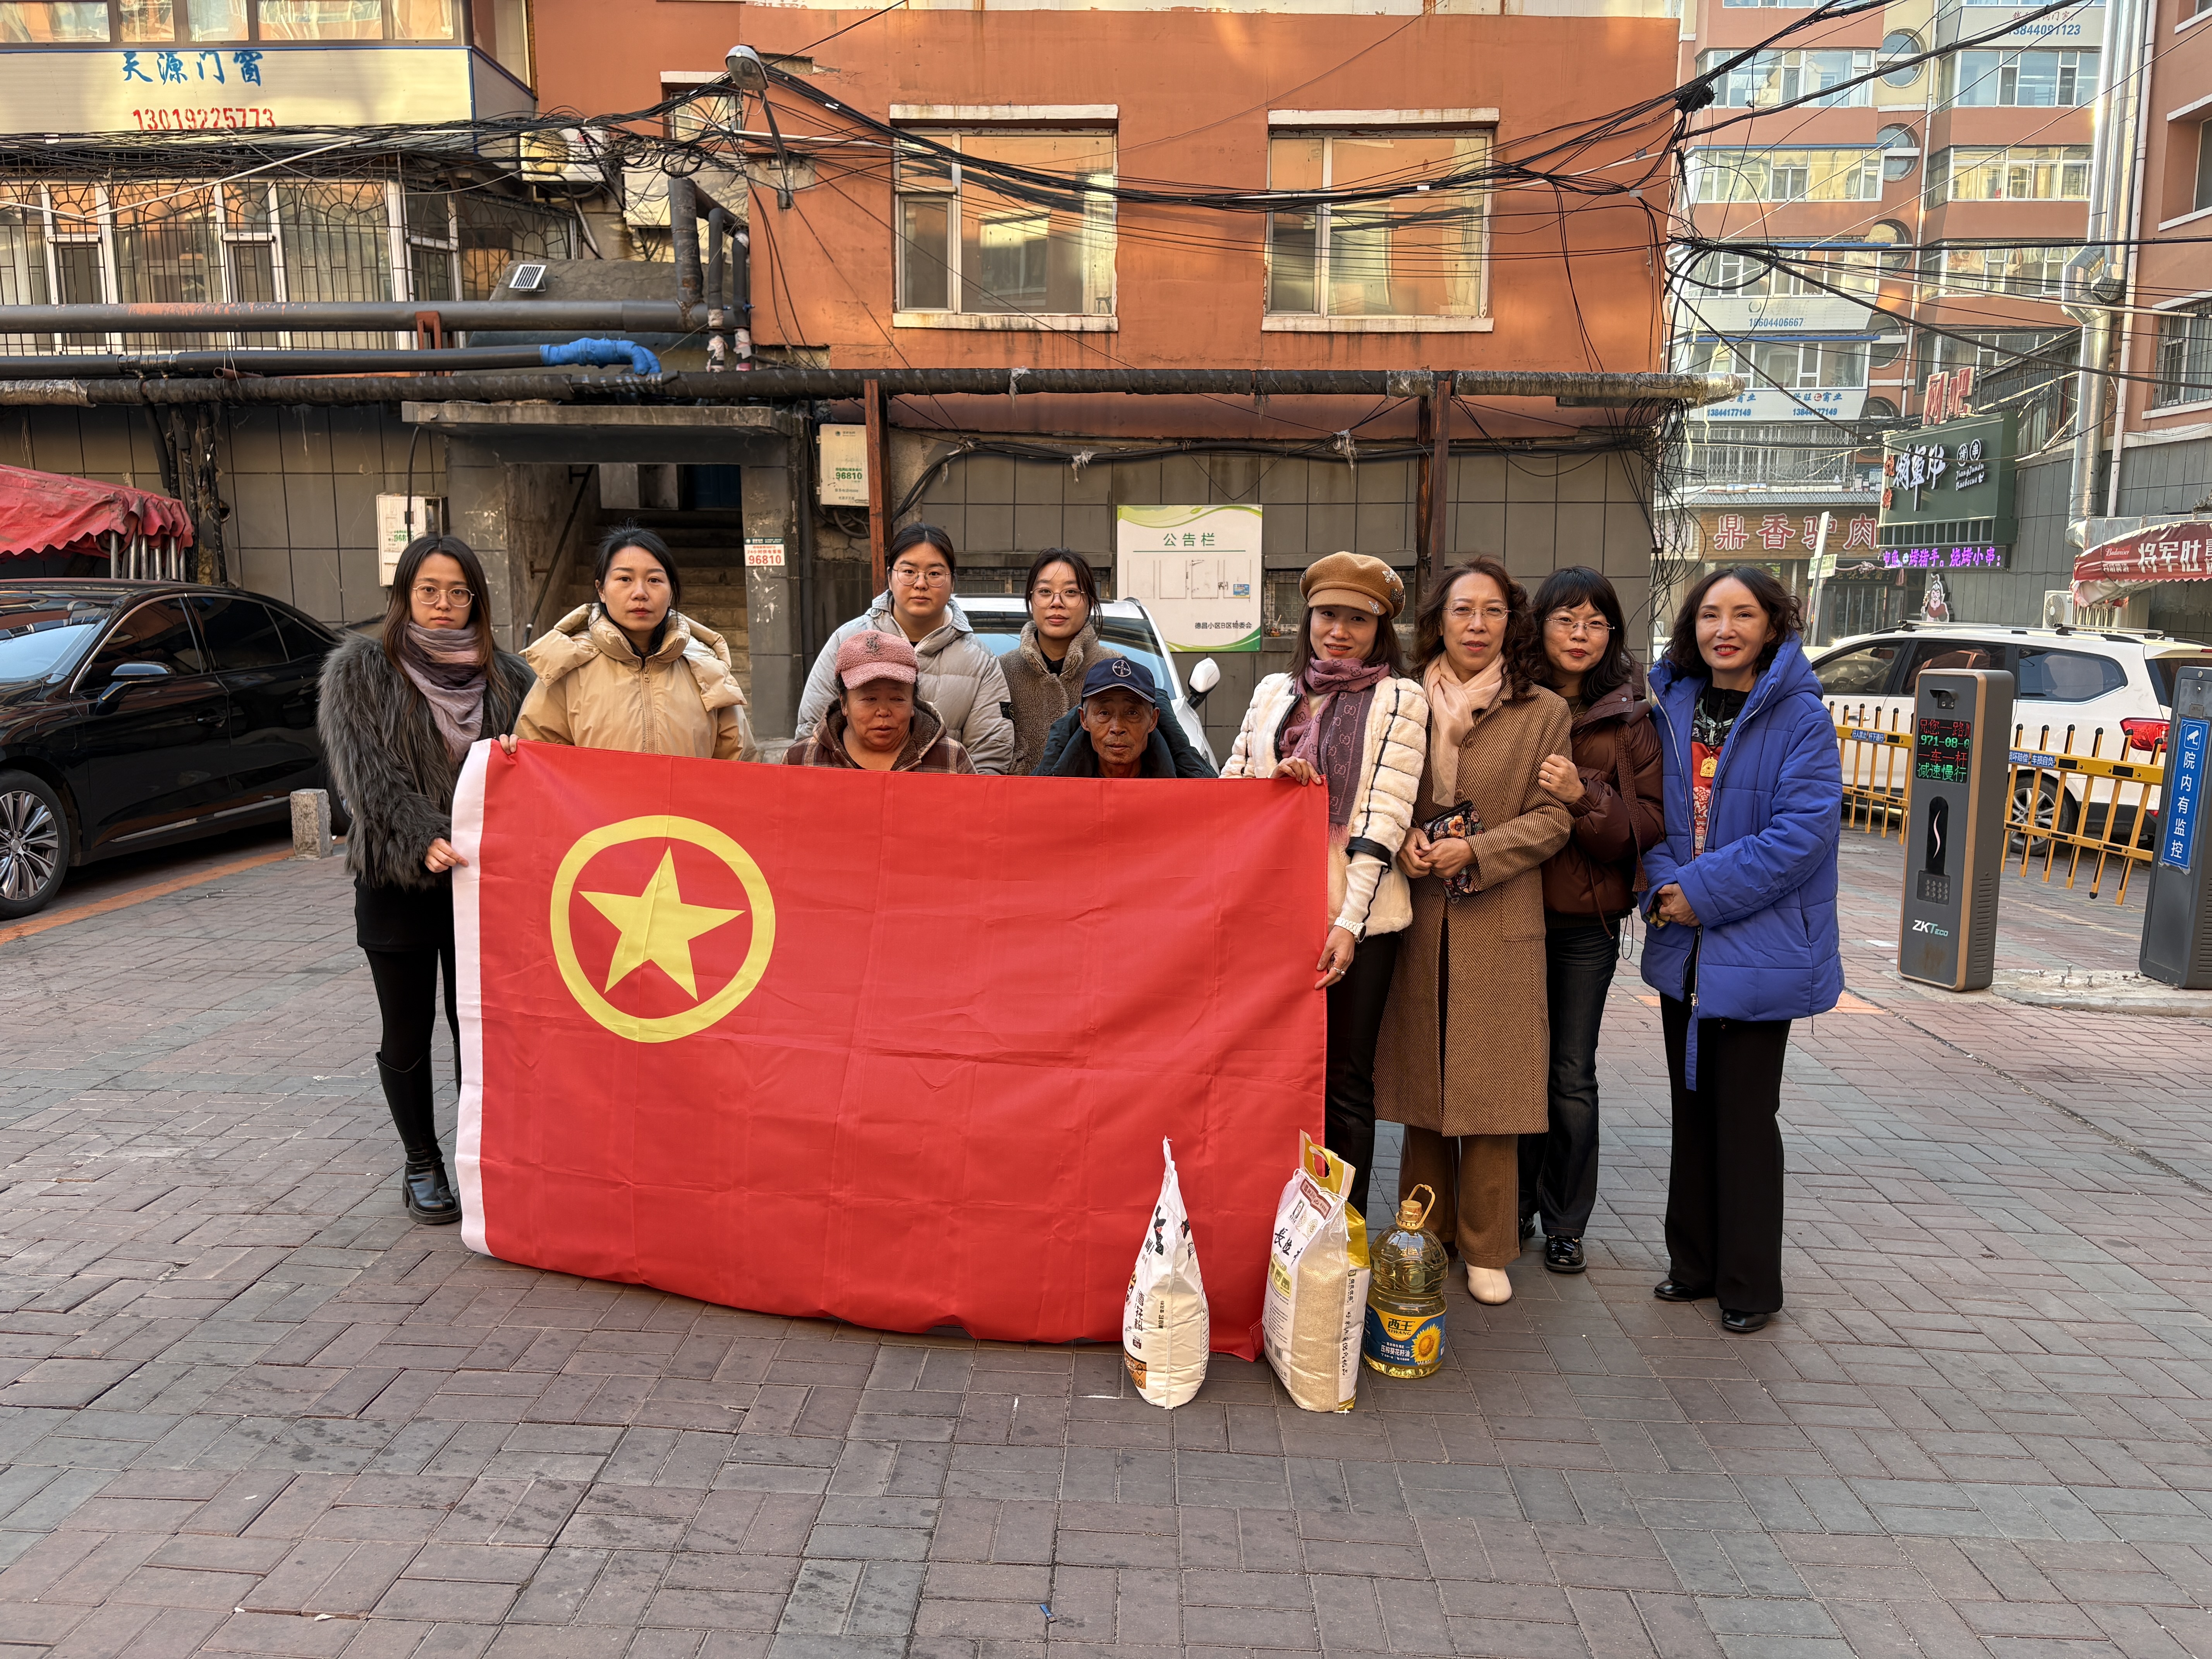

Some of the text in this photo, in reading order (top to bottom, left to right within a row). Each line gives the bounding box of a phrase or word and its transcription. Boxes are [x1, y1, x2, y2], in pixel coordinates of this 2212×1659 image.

[122, 52, 263, 86] 天源门窗
[133, 107, 276, 131] 13019225773
[1749, 318, 1804, 327] 18604406667
[1922, 367, 1975, 425] 网吧
[1707, 408, 1752, 417] 13844177149
[1163, 532, 1215, 546] 公告栏
[1713, 512, 1877, 551] 鼎香驴肉
[749, 555, 781, 564] 96810
[2105, 546, 2130, 556] Budweiser
[2137, 539, 2202, 573] 将军肚
[1919, 734, 1970, 749] 971-08-0
[1918, 749, 1968, 768] 一车一杆
[2031, 754, 2054, 766] 车损自负
[1917, 762, 1967, 783] 减速慢行
[2171, 751, 2196, 859] 院内有监控
[1134, 1290, 1145, 1332] 雪花粉
[1388, 1317, 1414, 1331] 西王
[1381, 1344, 1410, 1357] 压榨葵花籽油
